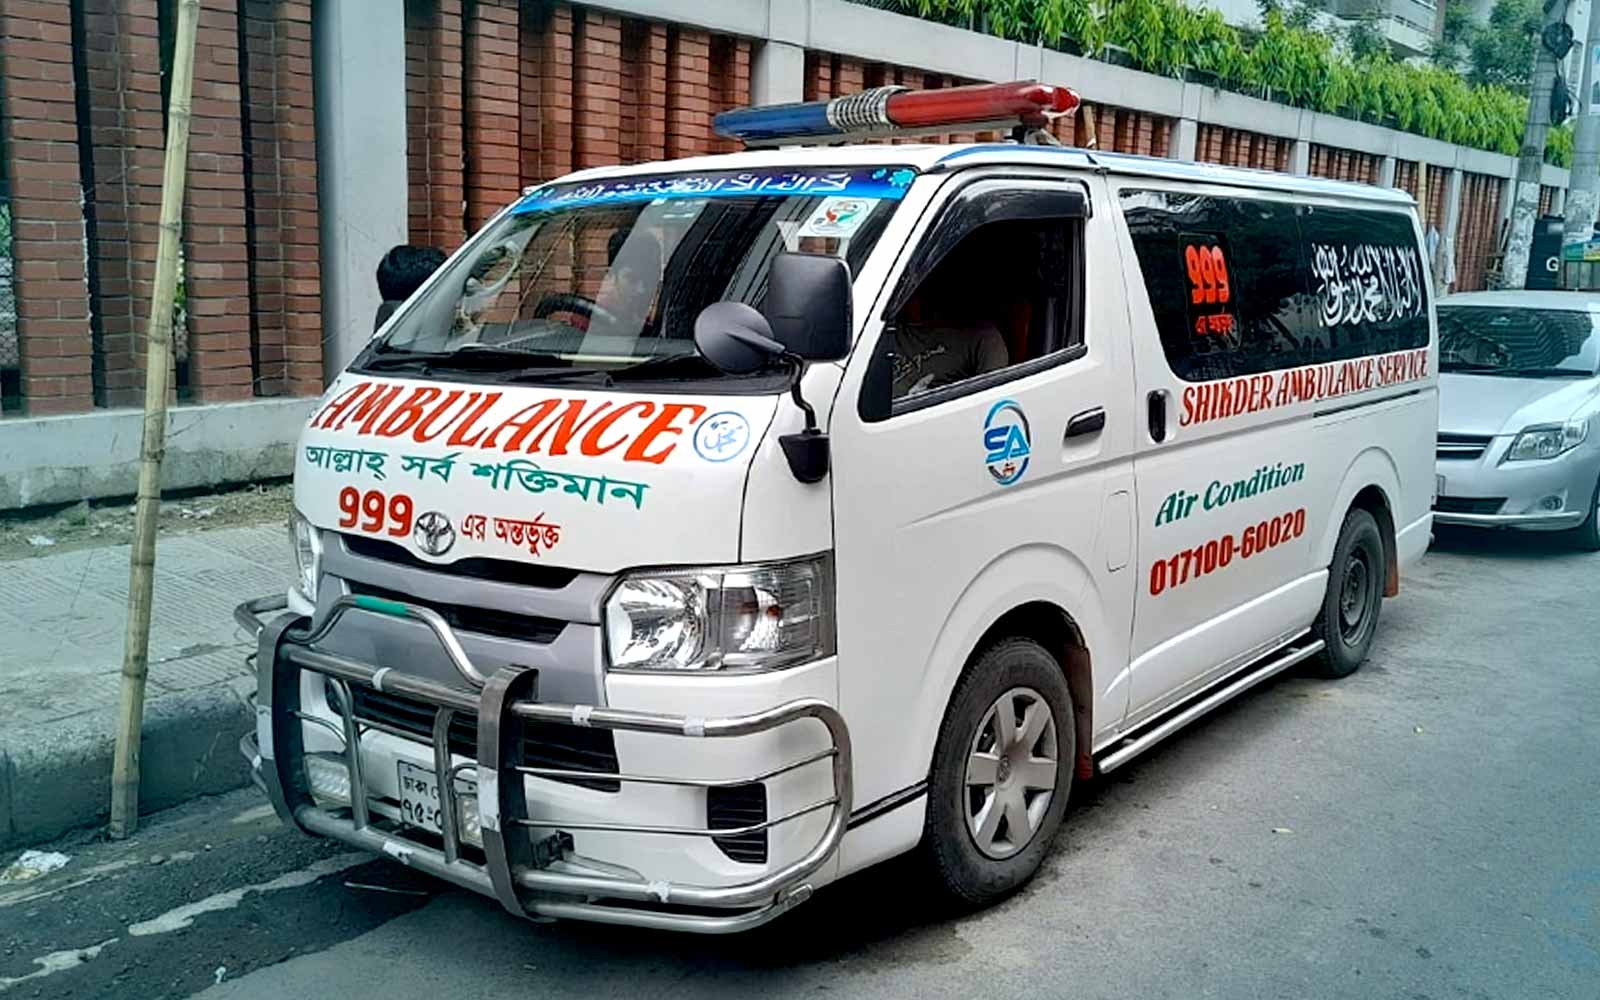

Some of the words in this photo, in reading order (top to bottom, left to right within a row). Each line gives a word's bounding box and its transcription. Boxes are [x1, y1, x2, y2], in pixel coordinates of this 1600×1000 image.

[1185, 245, 1231, 304] 999
[1179, 375, 1274, 426] SHIKDER
[1275, 358, 1375, 407] AMBULANCE
[1376, 350, 1428, 386] SERVICE
[310, 381, 707, 464] AMBULANCE
[338, 486, 414, 538] 999
[401, 452, 463, 483] সর্ব
[470, 459, 651, 510] শক্তিমান
[1154, 489, 1199, 527] Air
[1203, 461, 1305, 511] Condition
[461, 513, 487, 542] এর
[1149, 508, 1306, 596] 017100-60020
